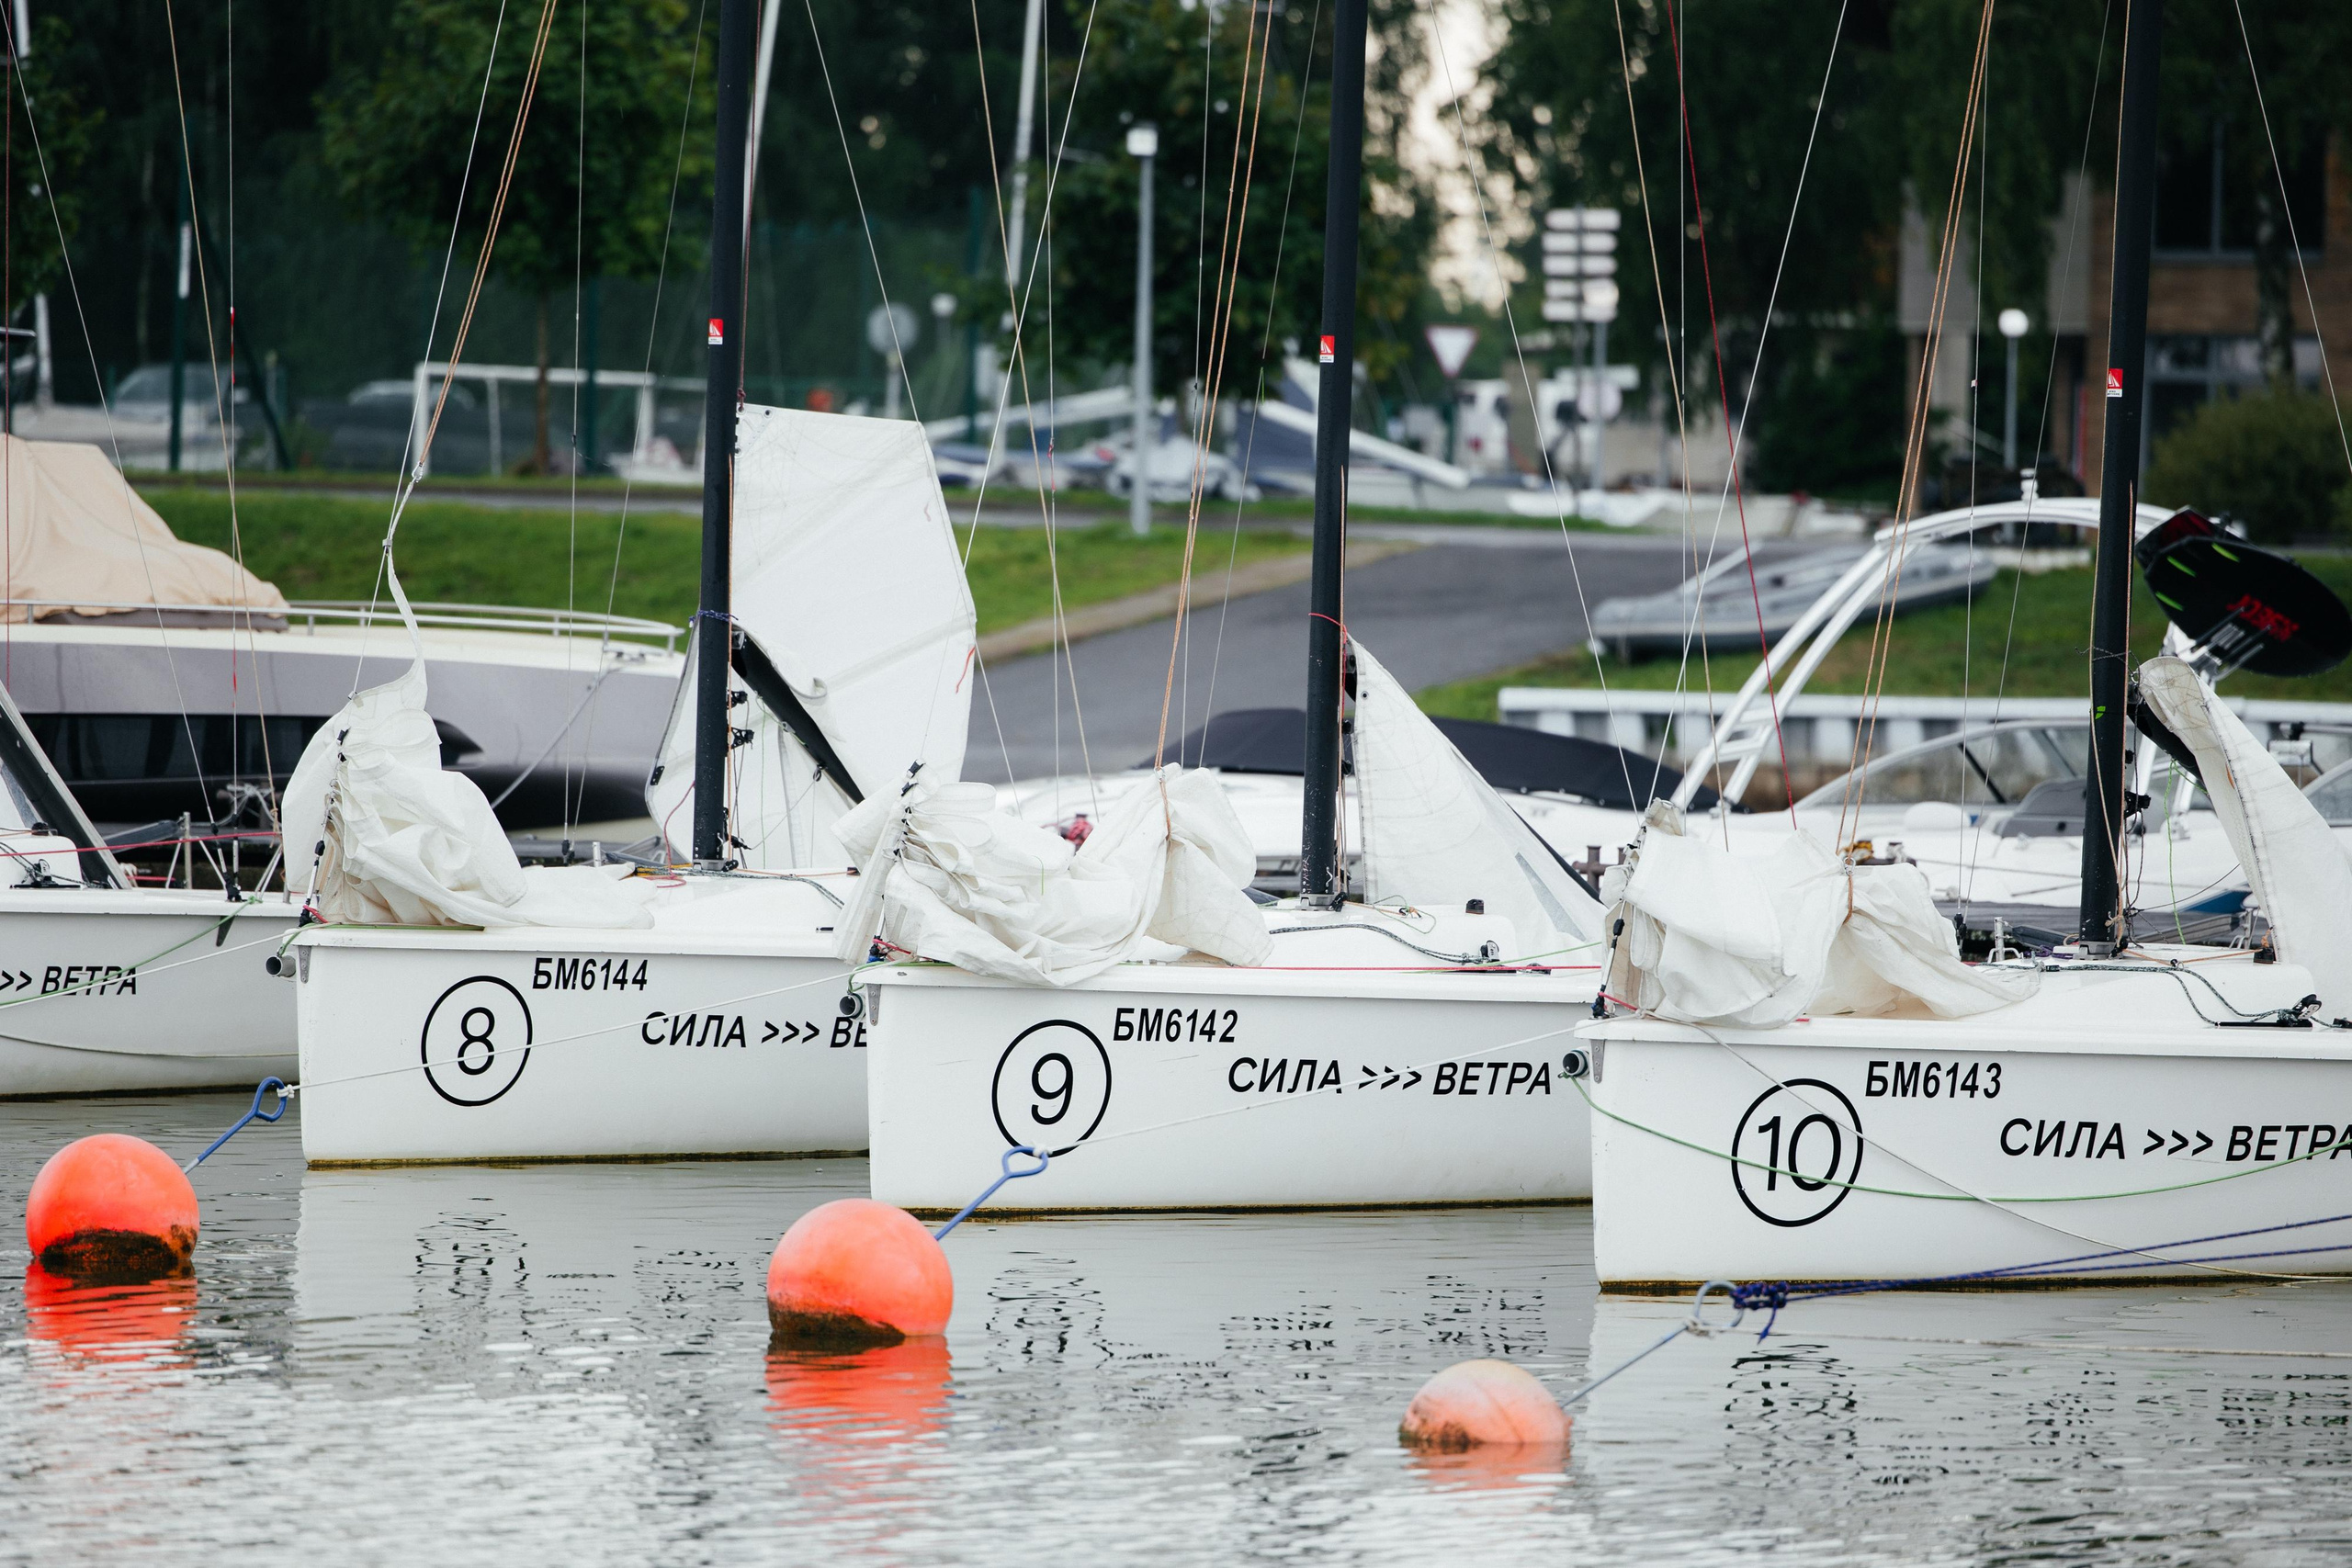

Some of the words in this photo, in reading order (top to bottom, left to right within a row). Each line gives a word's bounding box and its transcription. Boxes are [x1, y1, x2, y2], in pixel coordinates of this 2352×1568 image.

[40, 965, 137, 996] ВЕТРА
[532, 957, 649, 991] БМ6144
[457, 1006, 495, 1076] 8
[641, 1010, 747, 1048] СИЛА
[1113, 1007, 1238, 1043] БМ6142
[1031, 1052, 1074, 1125] 9
[1228, 1056, 1342, 1094] СИЛА
[1432, 1062, 1551, 1095] ВЕТРА
[1865, 1060, 2002, 1099] БМ6143
[1758, 1113, 1842, 1192] 10
[2000, 1117, 2126, 1160] СИЛА
[2225, 1123, 2352, 1162] ВЕТРА
